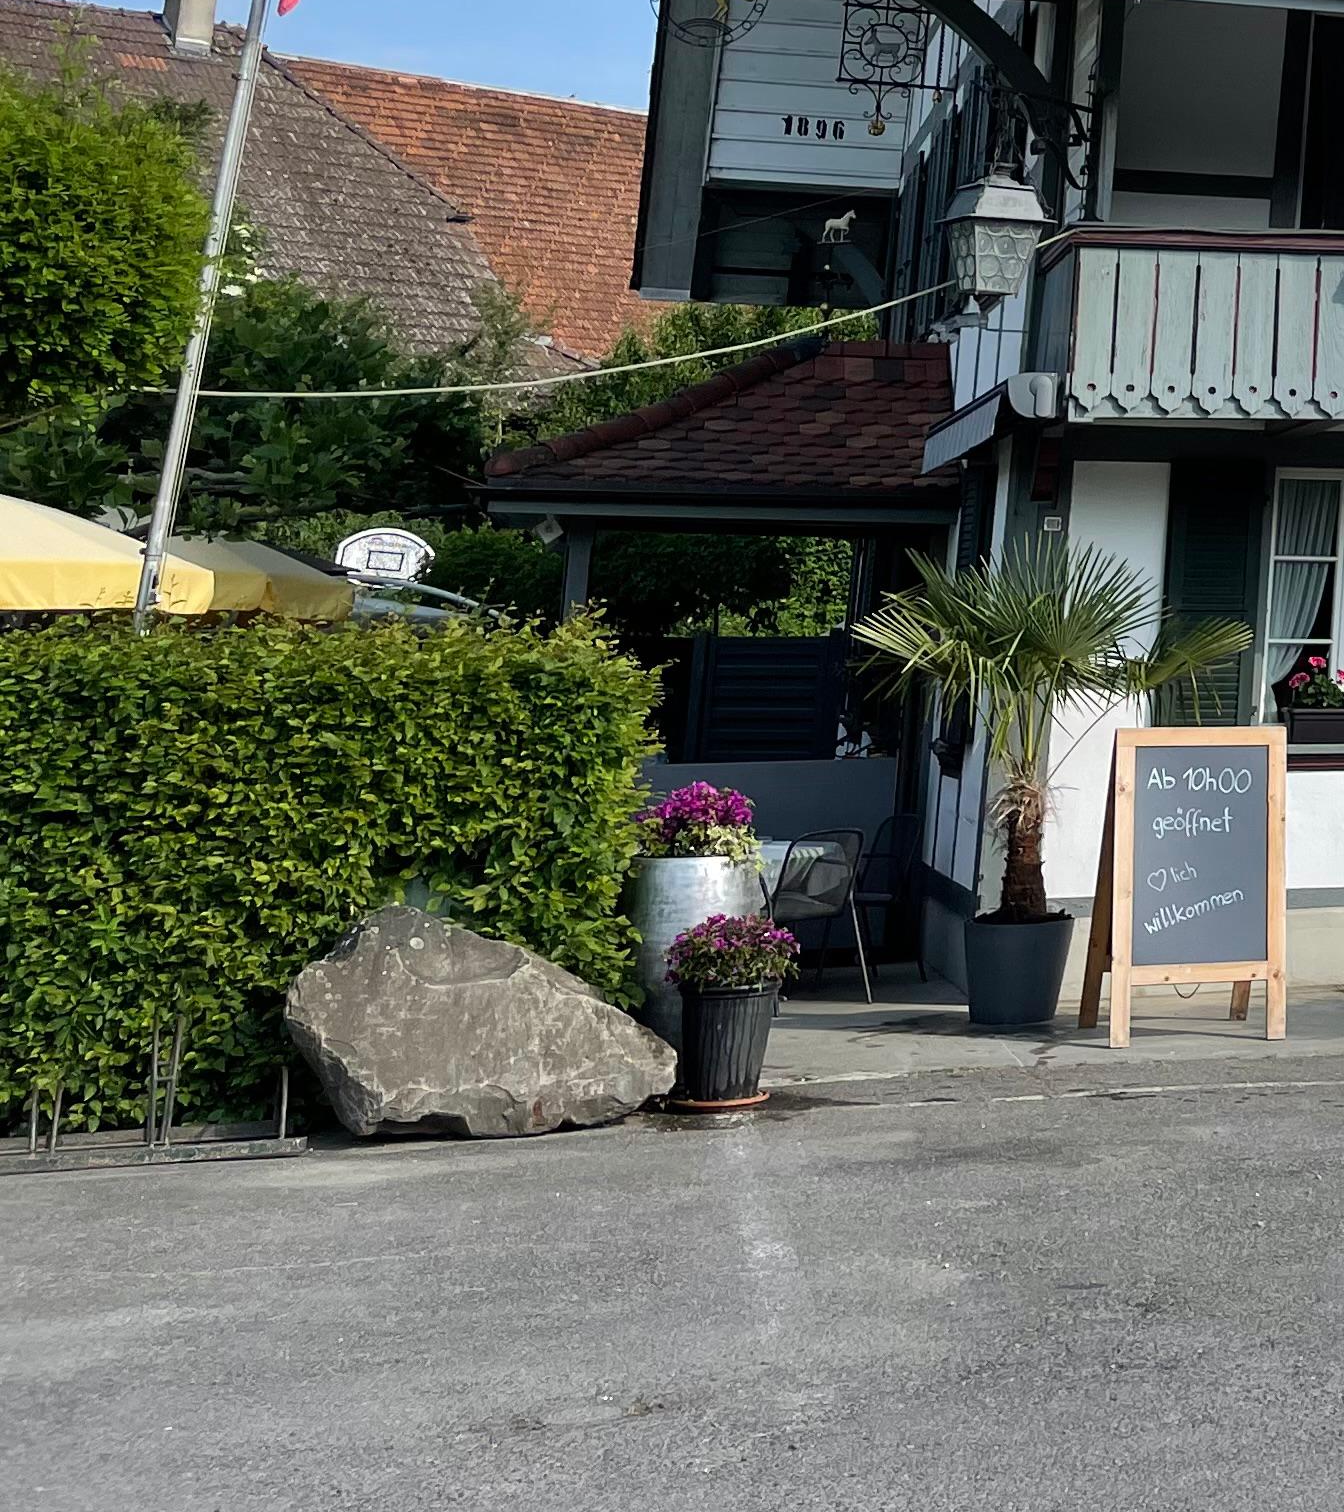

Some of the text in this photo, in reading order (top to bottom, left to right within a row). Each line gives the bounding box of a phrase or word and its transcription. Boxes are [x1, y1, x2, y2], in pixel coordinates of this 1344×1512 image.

[782, 115, 844, 140] 1896
[1147, 767, 1252, 794] Ab 10h00
[1152, 806, 1234, 839] geöffnet
[1170, 861, 1198, 884] lich
[1144, 889, 1244, 935] willkommen
